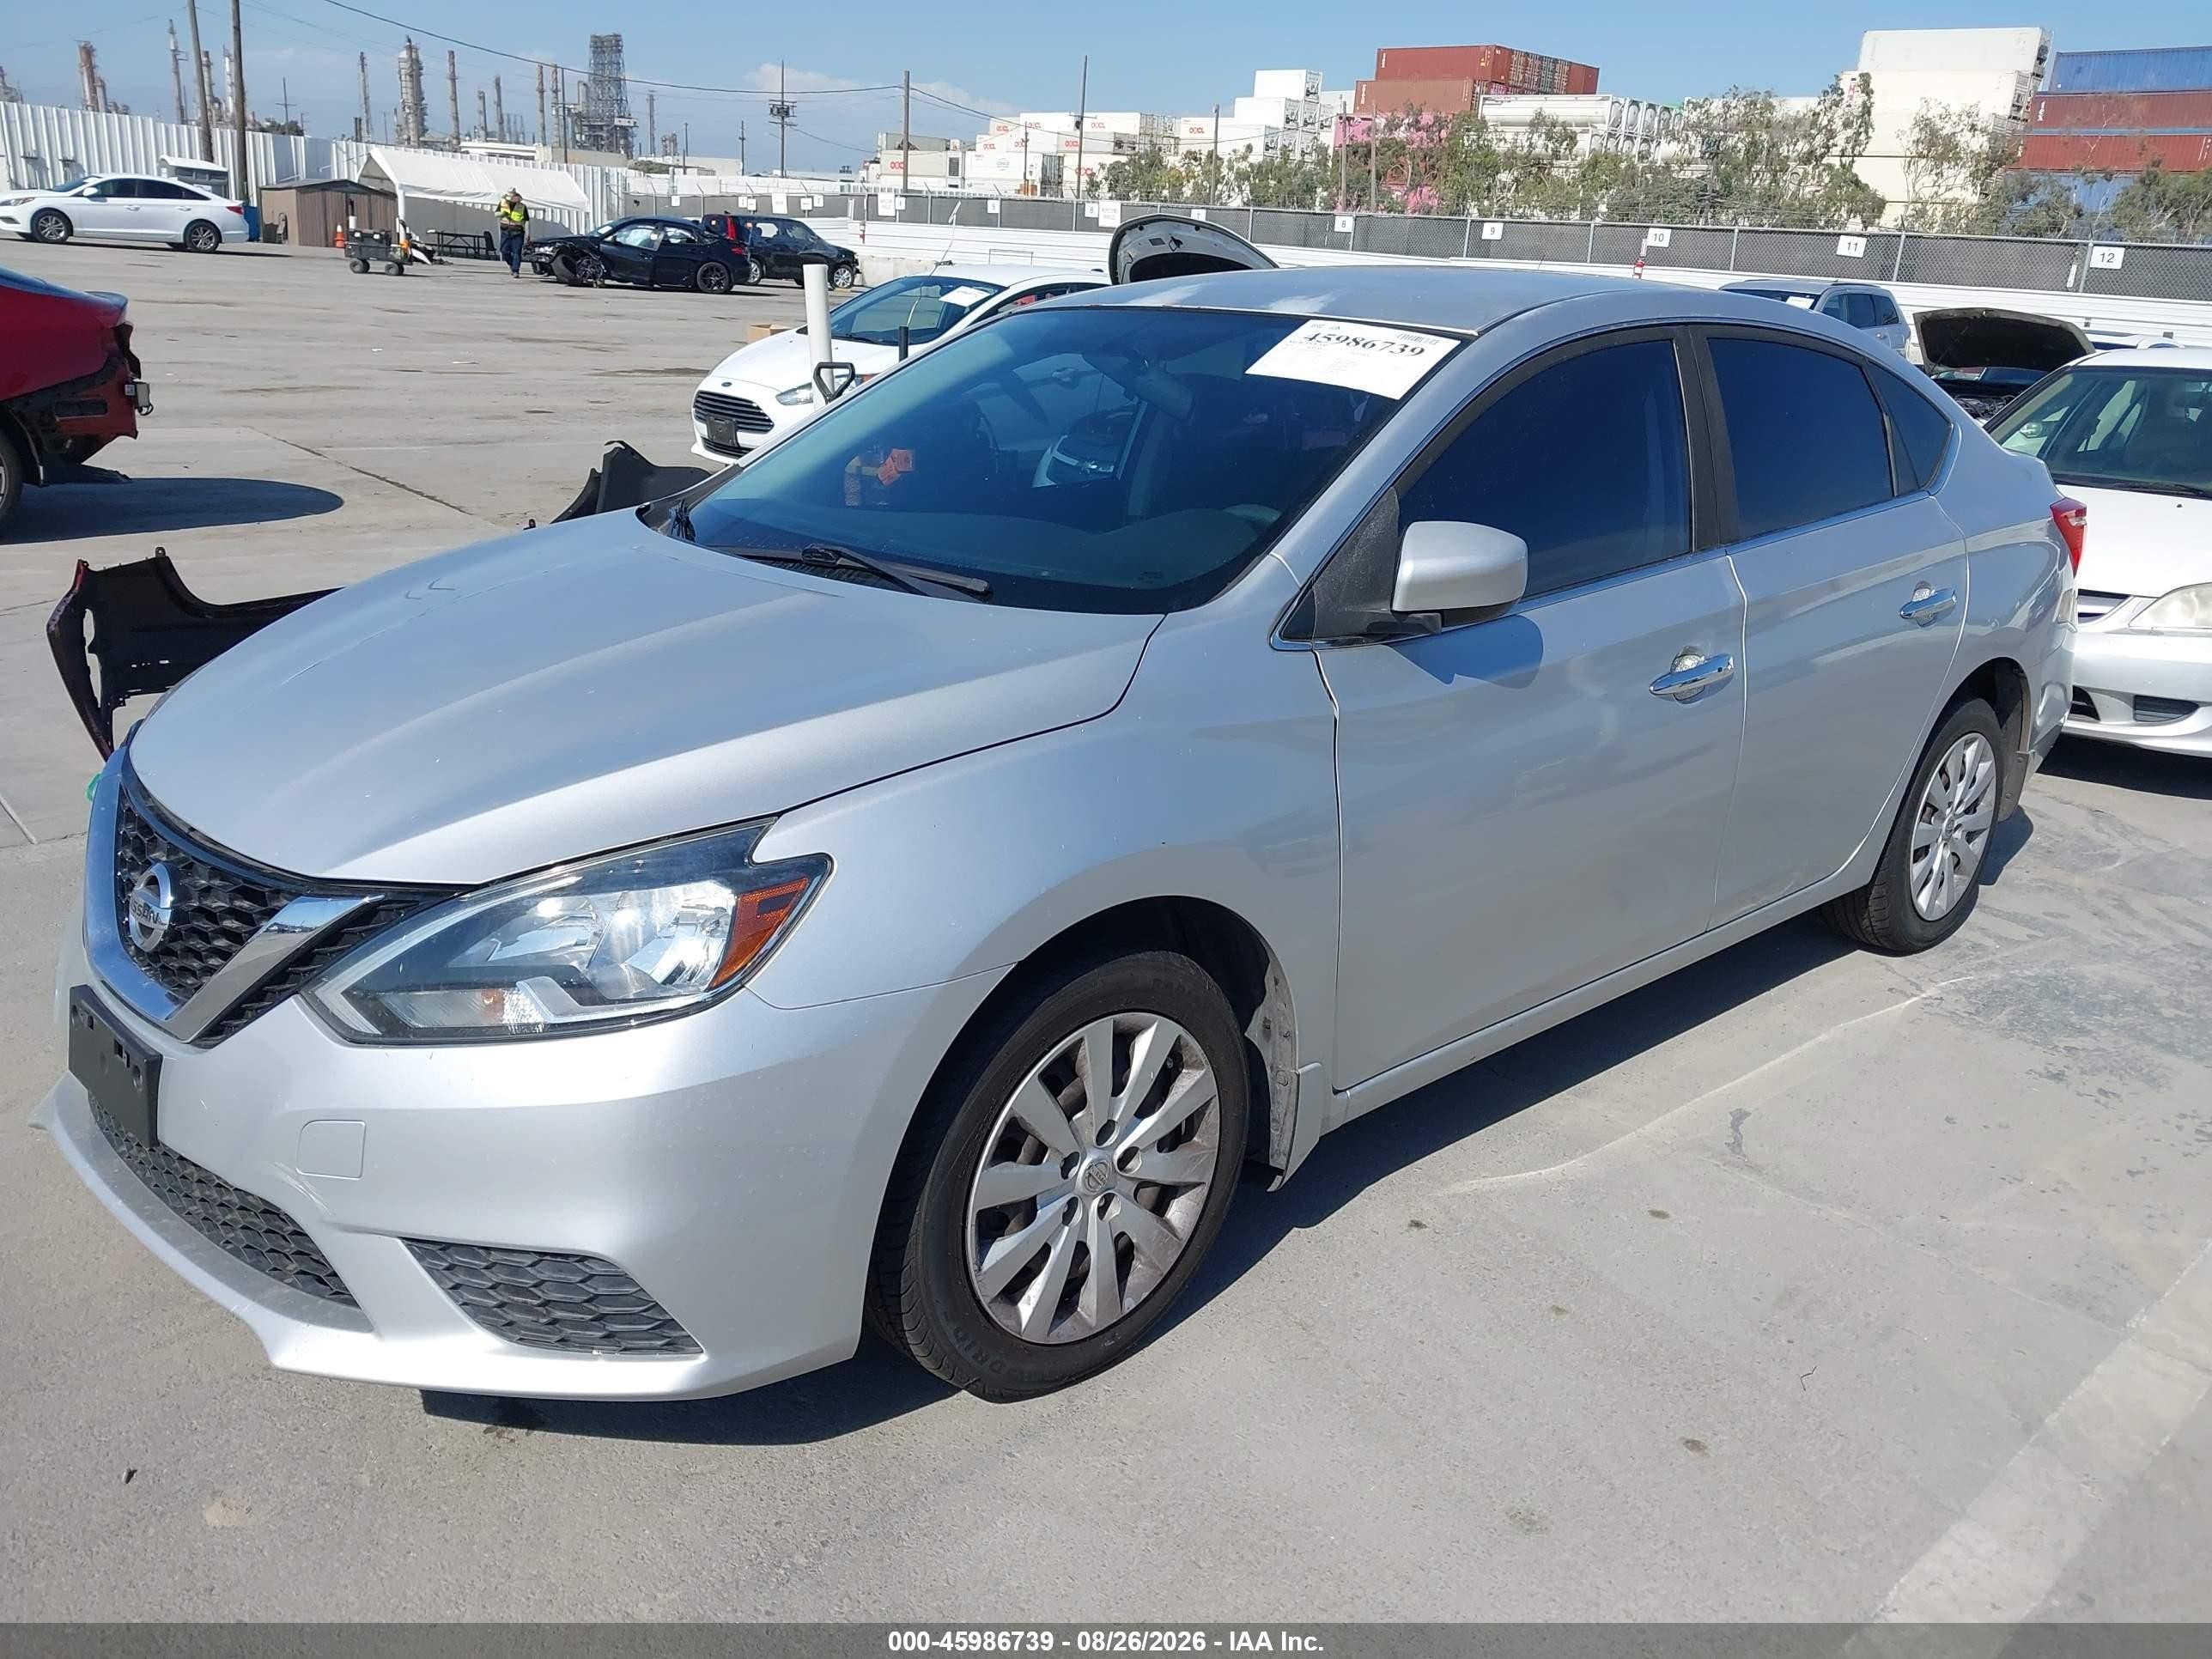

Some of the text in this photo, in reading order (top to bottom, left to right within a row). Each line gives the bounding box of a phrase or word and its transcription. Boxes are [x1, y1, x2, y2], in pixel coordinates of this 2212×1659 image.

[1489, 226, 1496, 235] 9
[1652, 233, 1665, 242] 10
[1847, 241, 1858, 252] 11
[2100, 252, 2116, 263] 12
[1304, 332, 1425, 357] 45986739
